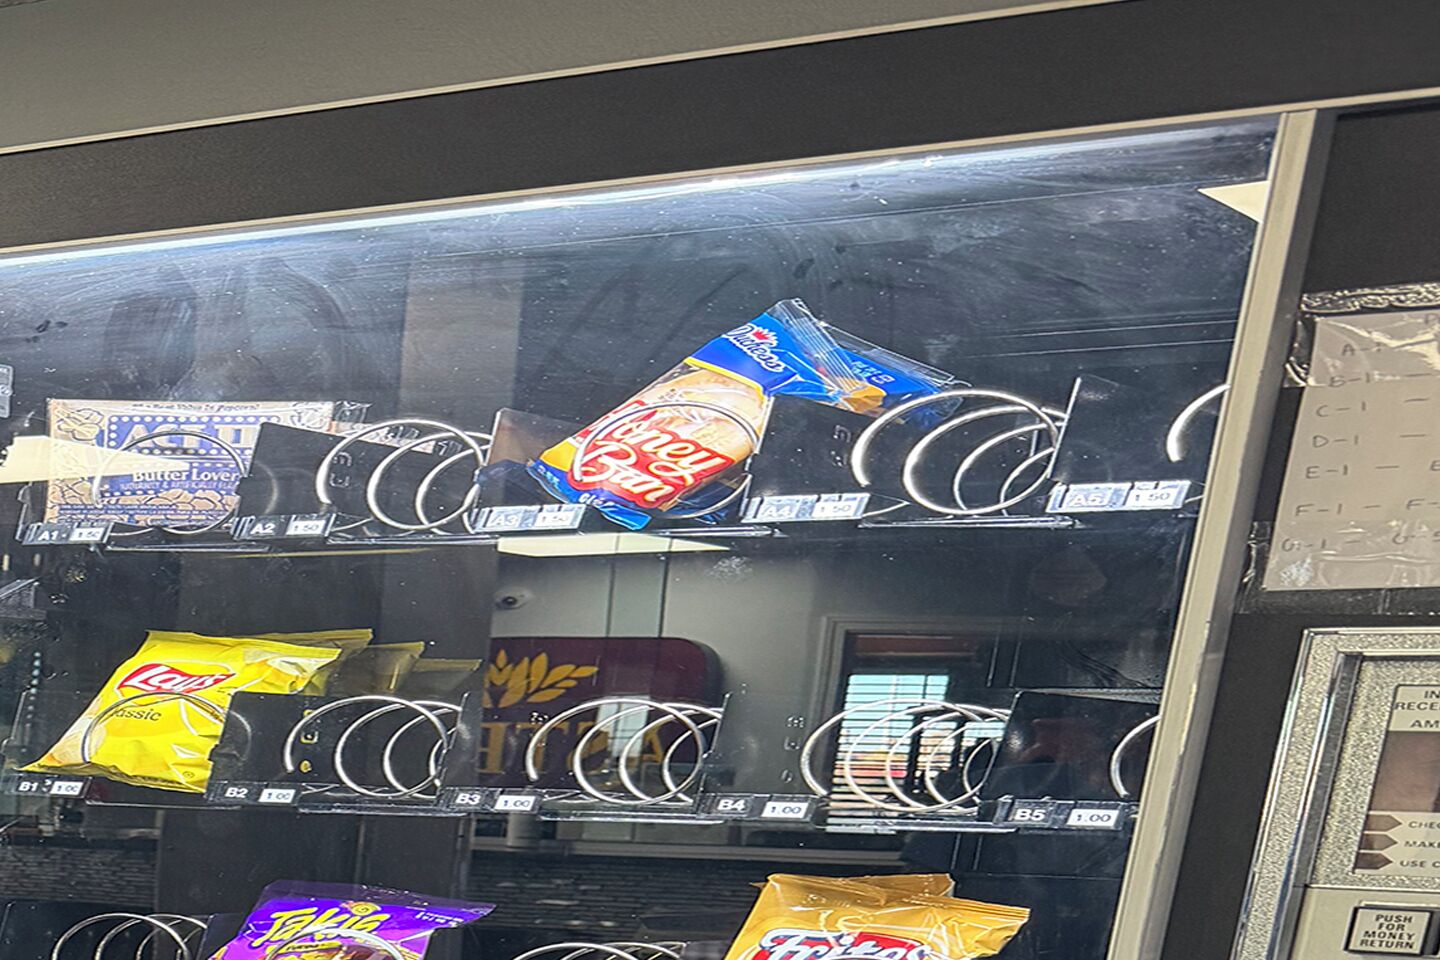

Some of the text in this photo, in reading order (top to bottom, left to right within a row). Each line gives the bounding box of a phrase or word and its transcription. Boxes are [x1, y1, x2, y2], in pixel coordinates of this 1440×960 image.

[121, 423, 207, 449] ACT
[132, 470, 191, 482] Butter
[251, 523, 274, 534] A2
[38, 530, 59, 541] A1
[19, 781, 38, 792] B1
[225, 787, 248, 799] B2
[456, 793, 480, 805] B3
[718, 799, 746, 812] B4
[1014, 808, 1046, 821] B5
[1400, 860, 1427, 868] USE
[1375, 913, 1413, 923] PUSH
[251, 906, 391, 948] Takis
[1377, 922, 1406, 932] FOR
[1363, 930, 1415, 941] MONEY
[1359, 939, 1414, 950] RETURN
